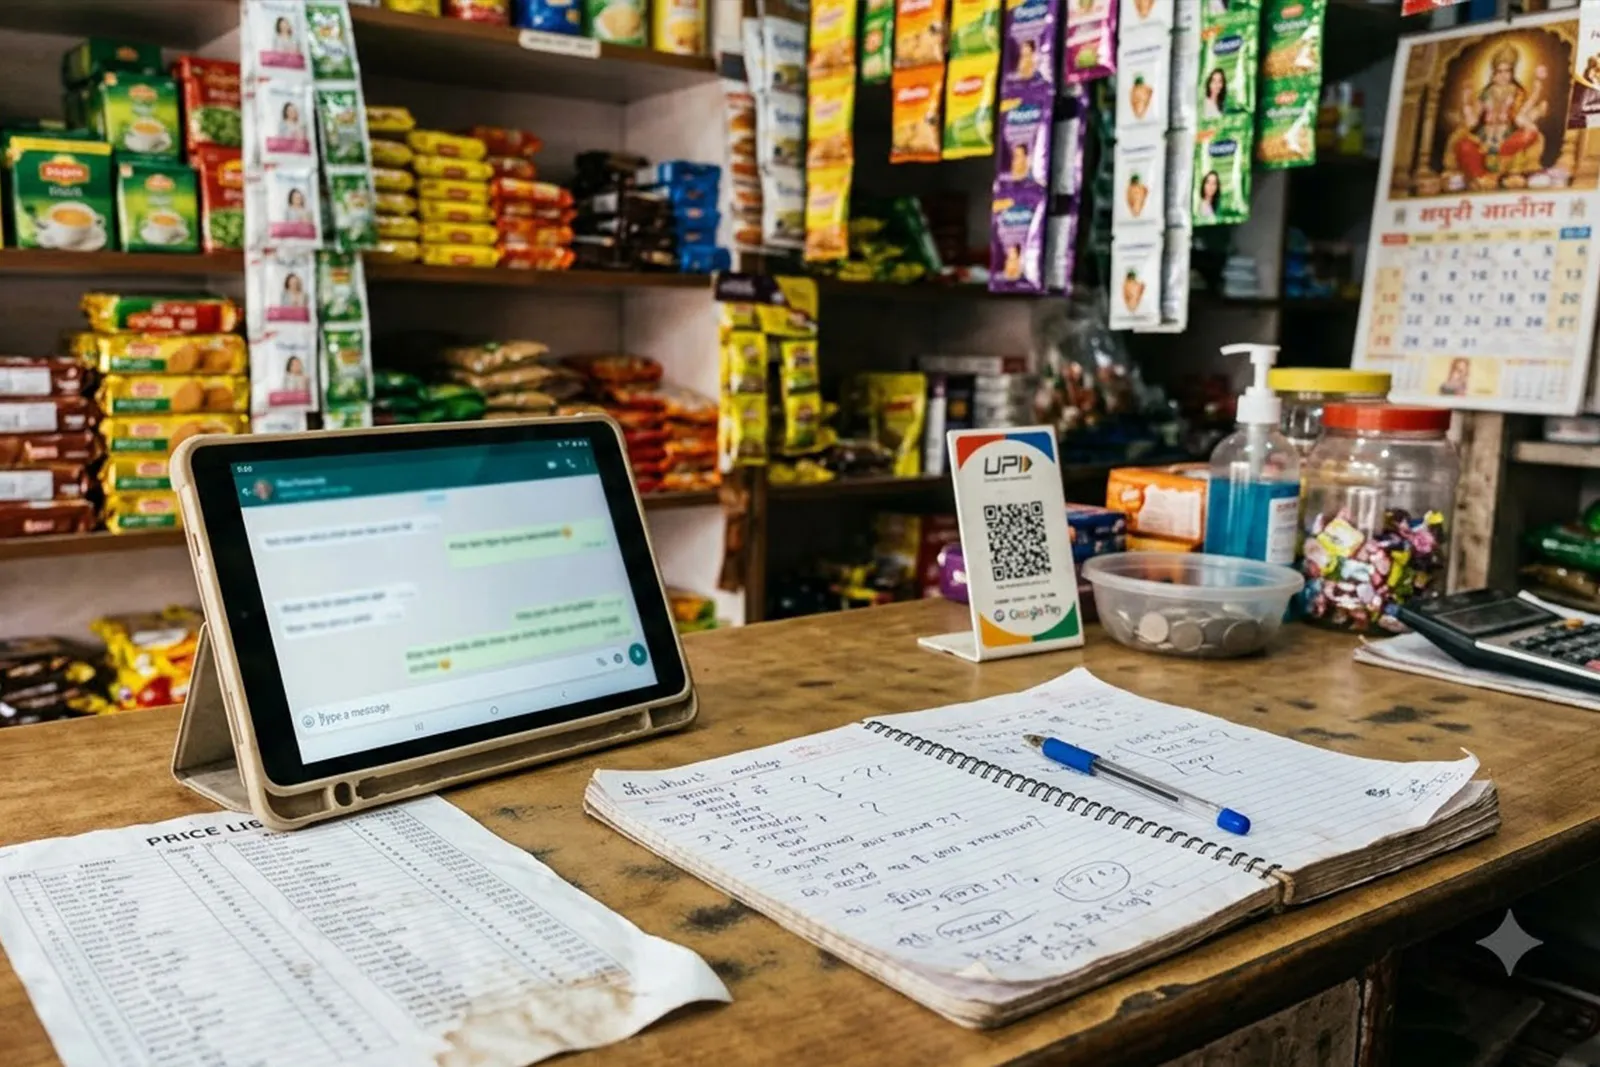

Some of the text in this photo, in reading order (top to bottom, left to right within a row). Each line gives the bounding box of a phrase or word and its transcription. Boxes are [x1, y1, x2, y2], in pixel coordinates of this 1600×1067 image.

[1450, 247, 1460, 260] 2
[1502, 269, 1518, 281] 11
[1532, 268, 1551, 281] 12
[1565, 267, 1583, 281] 13
[1468, 292, 1484, 303] 17
[1499, 292, 1515, 304] 18
[1529, 292, 1547, 303] 19
[1560, 291, 1580, 305] 20
[984, 455, 1023, 475] UPI
[146, 826, 221, 846] PRICE
